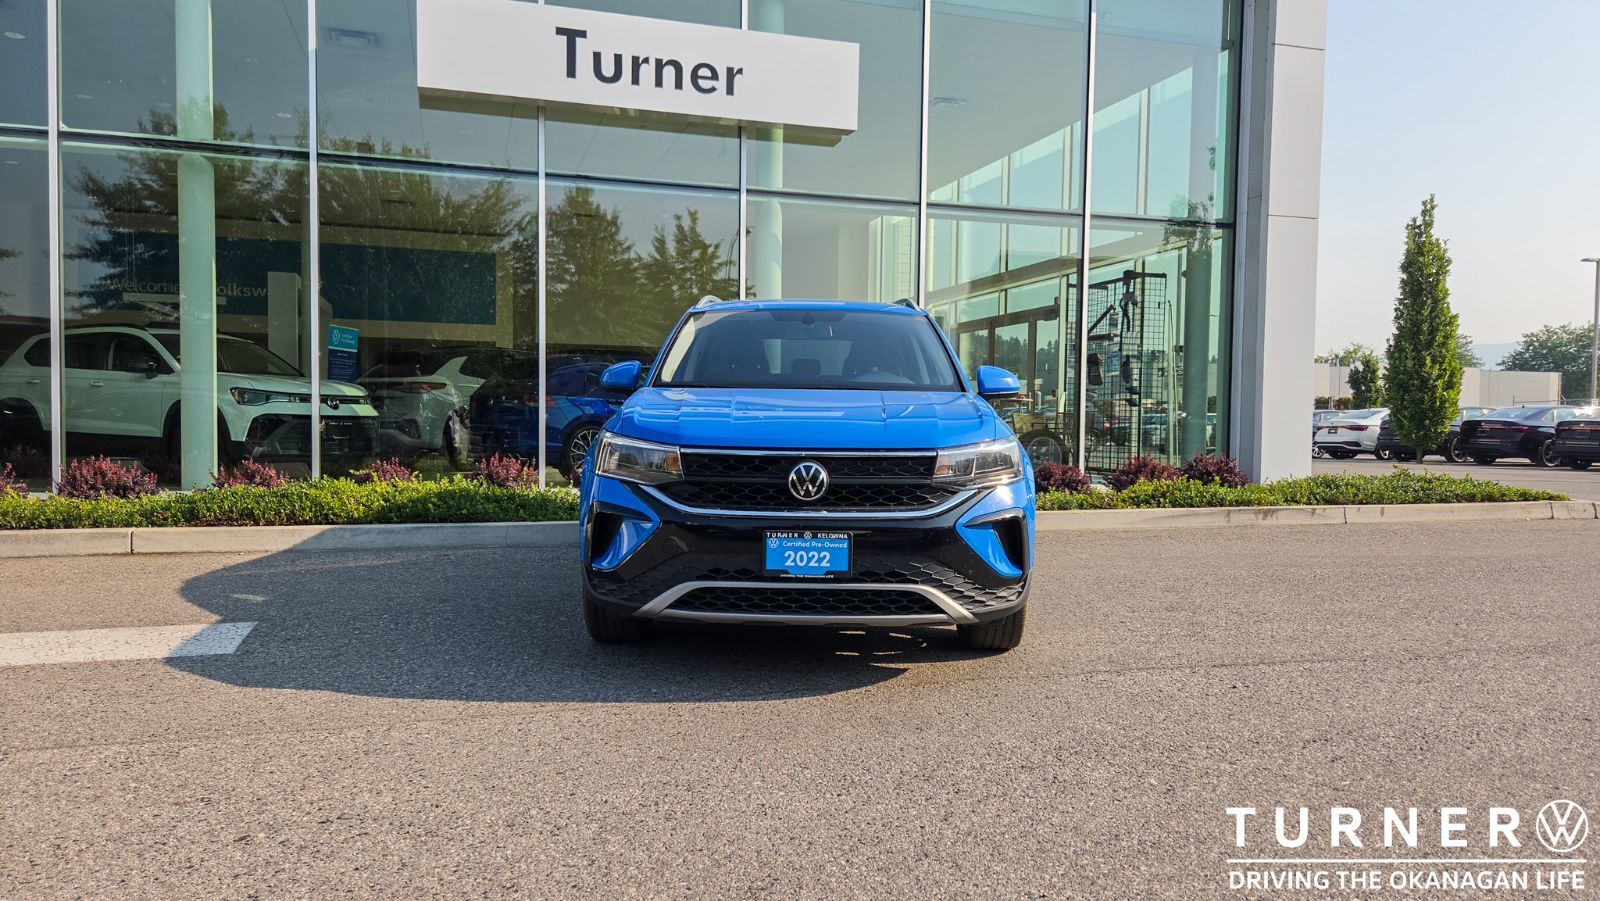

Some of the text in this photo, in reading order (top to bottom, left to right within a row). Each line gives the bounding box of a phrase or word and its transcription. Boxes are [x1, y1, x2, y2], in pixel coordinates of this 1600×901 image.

[555, 27, 744, 97] Turner
[217, 283, 268, 297] olksw
[784, 550, 831, 567] 2022
